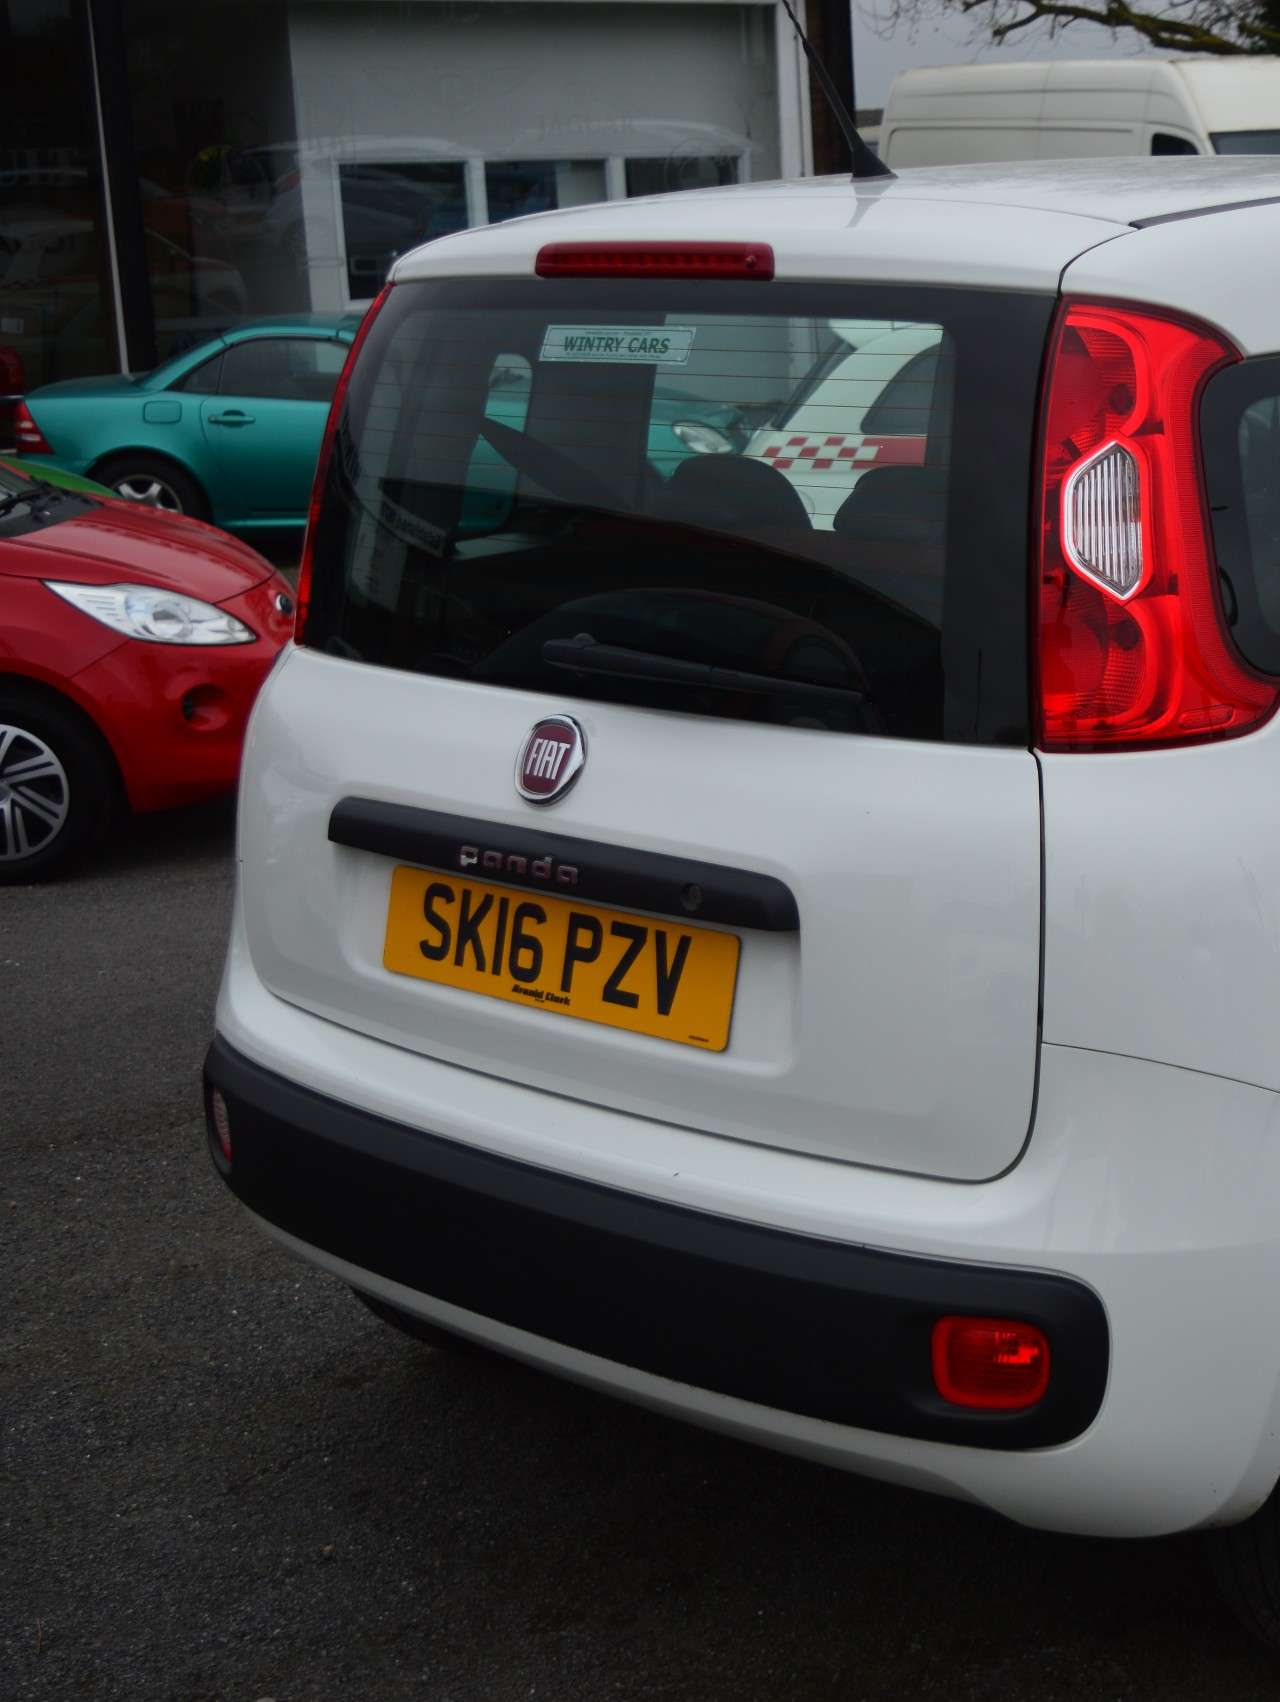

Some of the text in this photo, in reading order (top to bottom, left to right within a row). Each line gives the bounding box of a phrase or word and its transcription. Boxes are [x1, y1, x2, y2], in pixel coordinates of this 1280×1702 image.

[564, 335, 671, 354] WINTRY CARS
[524, 738, 571, 780] FIAT
[419, 881, 692, 1017] SK16 PZV
